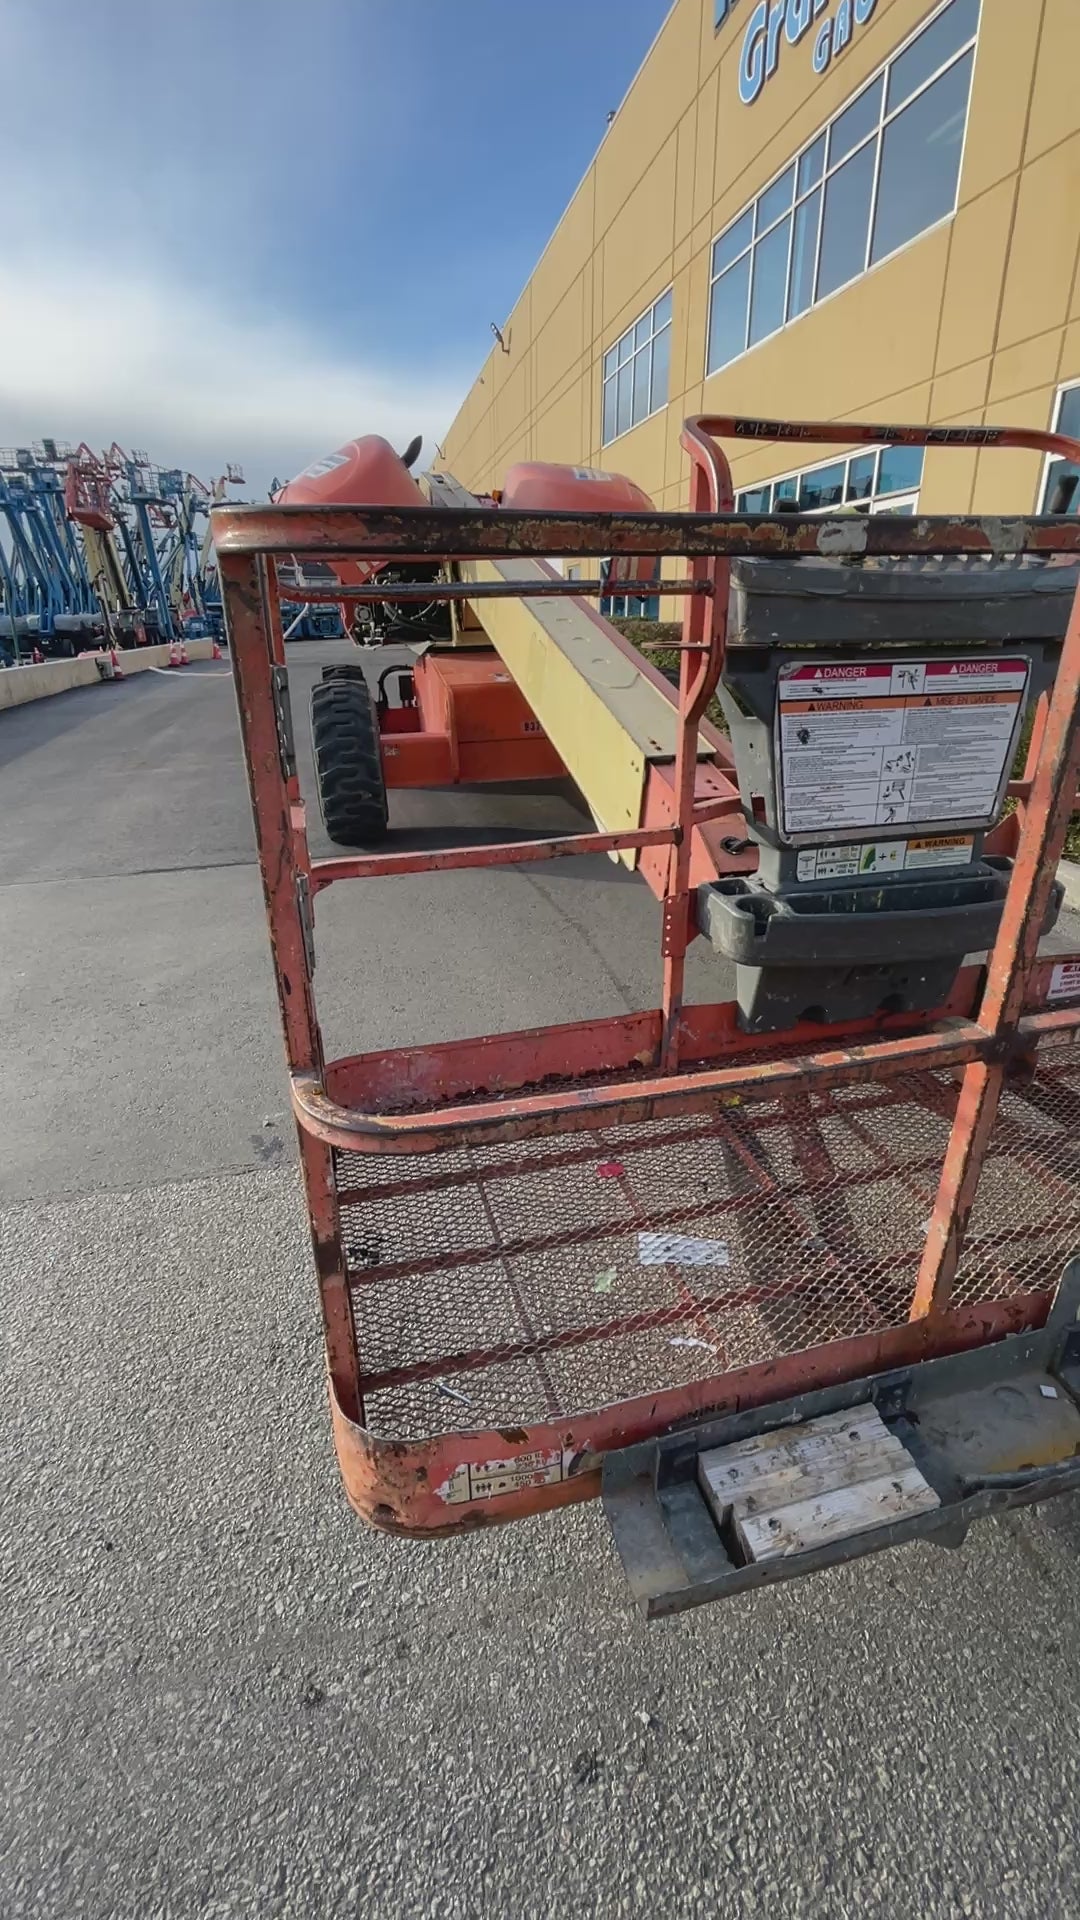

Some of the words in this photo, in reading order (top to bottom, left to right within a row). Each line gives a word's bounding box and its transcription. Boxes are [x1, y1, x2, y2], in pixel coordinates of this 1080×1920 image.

[824, 667, 867, 678] DANGER
[959, 663, 998, 673] DANGER
[816, 700, 864, 711] WARNING
[925, 837, 965, 848] WARNING
